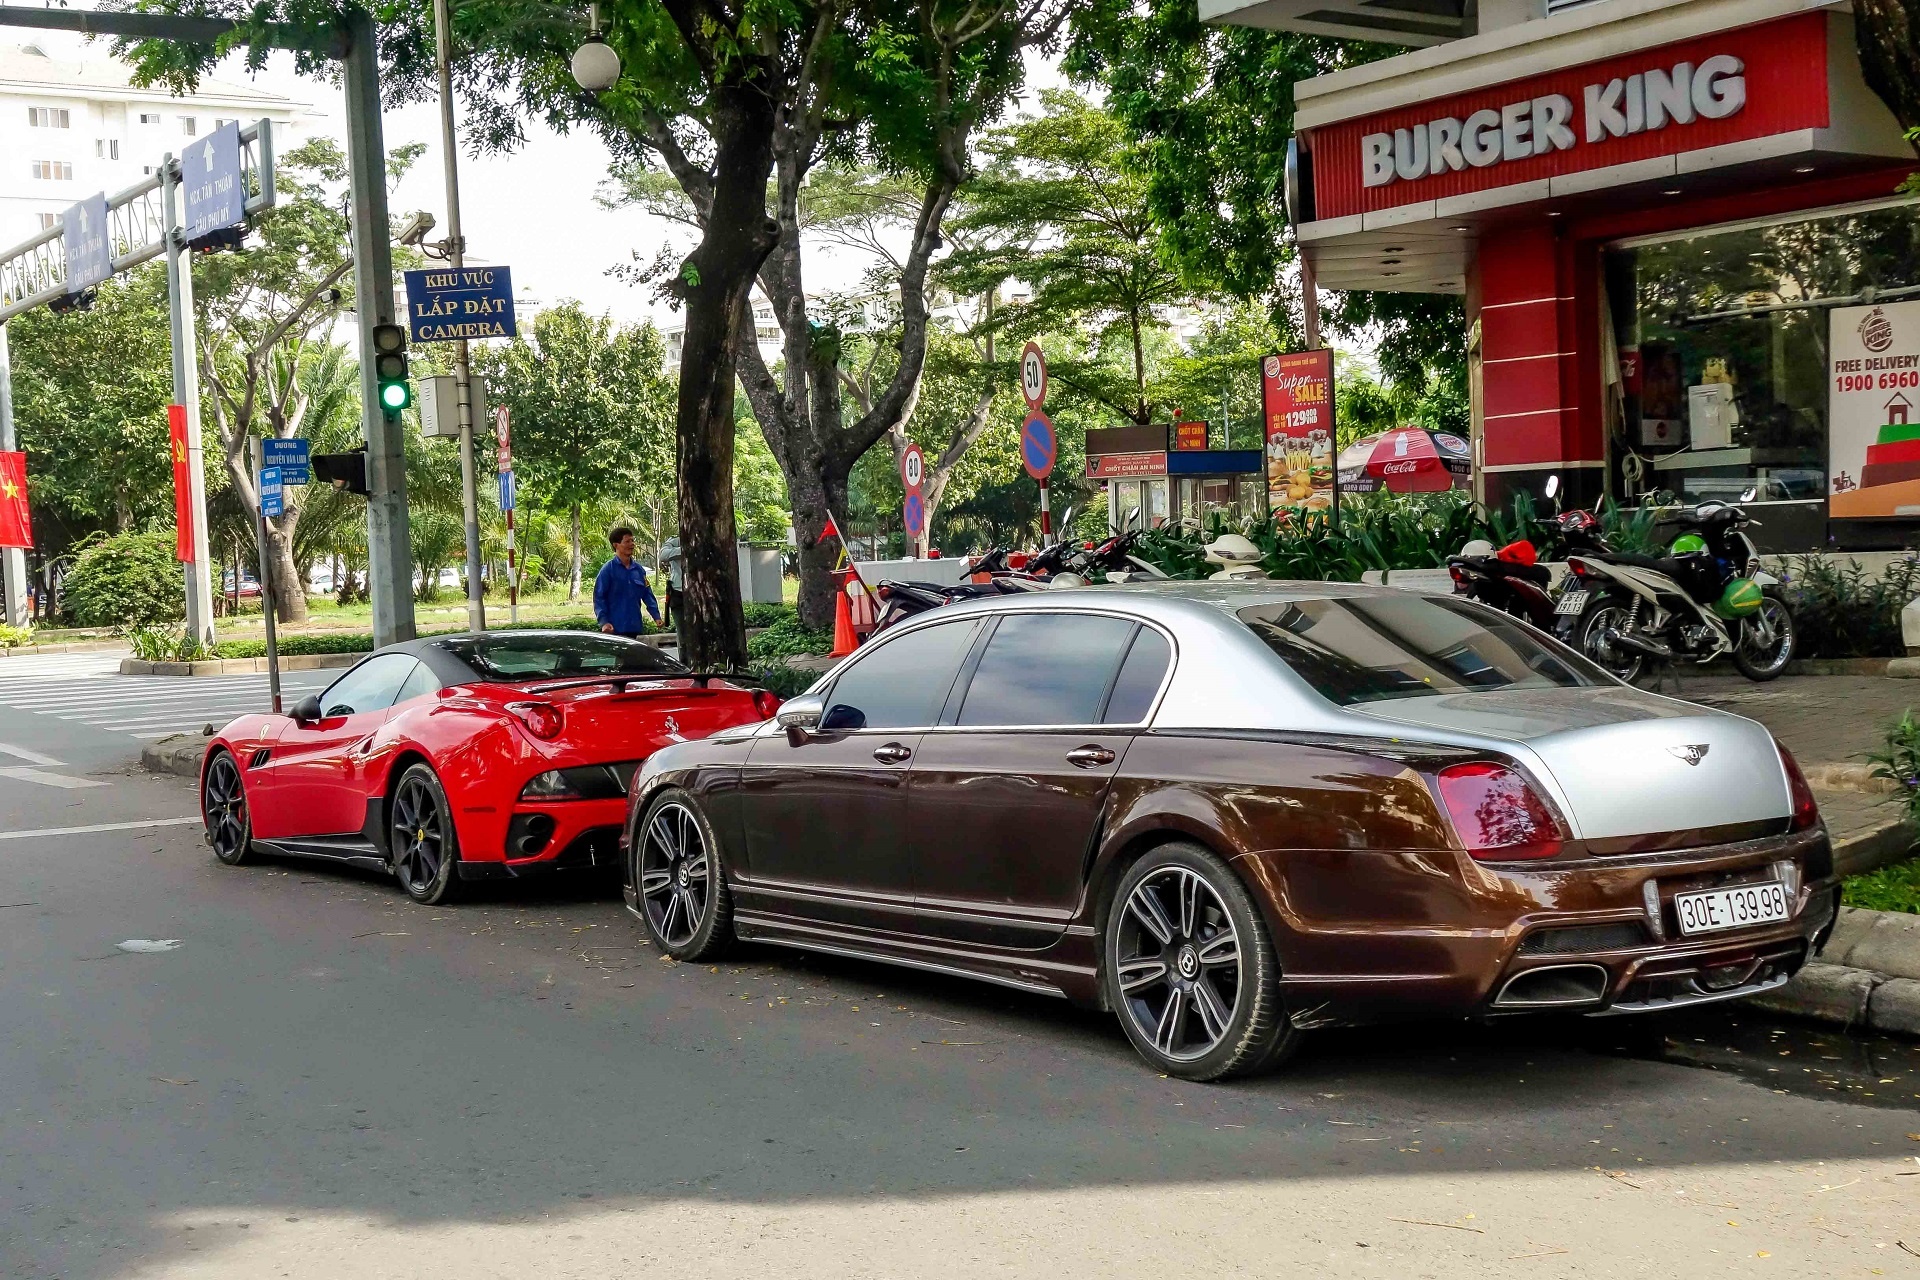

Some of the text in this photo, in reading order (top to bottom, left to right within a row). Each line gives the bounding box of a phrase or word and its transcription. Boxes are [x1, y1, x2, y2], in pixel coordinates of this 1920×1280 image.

[1361, 54, 1747, 188] BURGER KING
[425, 269, 494, 288] KHU VỰC
[416, 295, 506, 317] LẮP ĐẶT
[419, 321, 506, 340] CAMERA
[1866, 328, 1892, 347] KING
[1835, 354, 1920, 373] FREE DELIVERY
[1026, 361, 1039, 389] 50
[1277, 372, 1311, 396] Super
[1835, 371, 1919, 392] 1900 6960
[1295, 383, 1324, 403] SALE
[908, 457, 919, 478] 80
